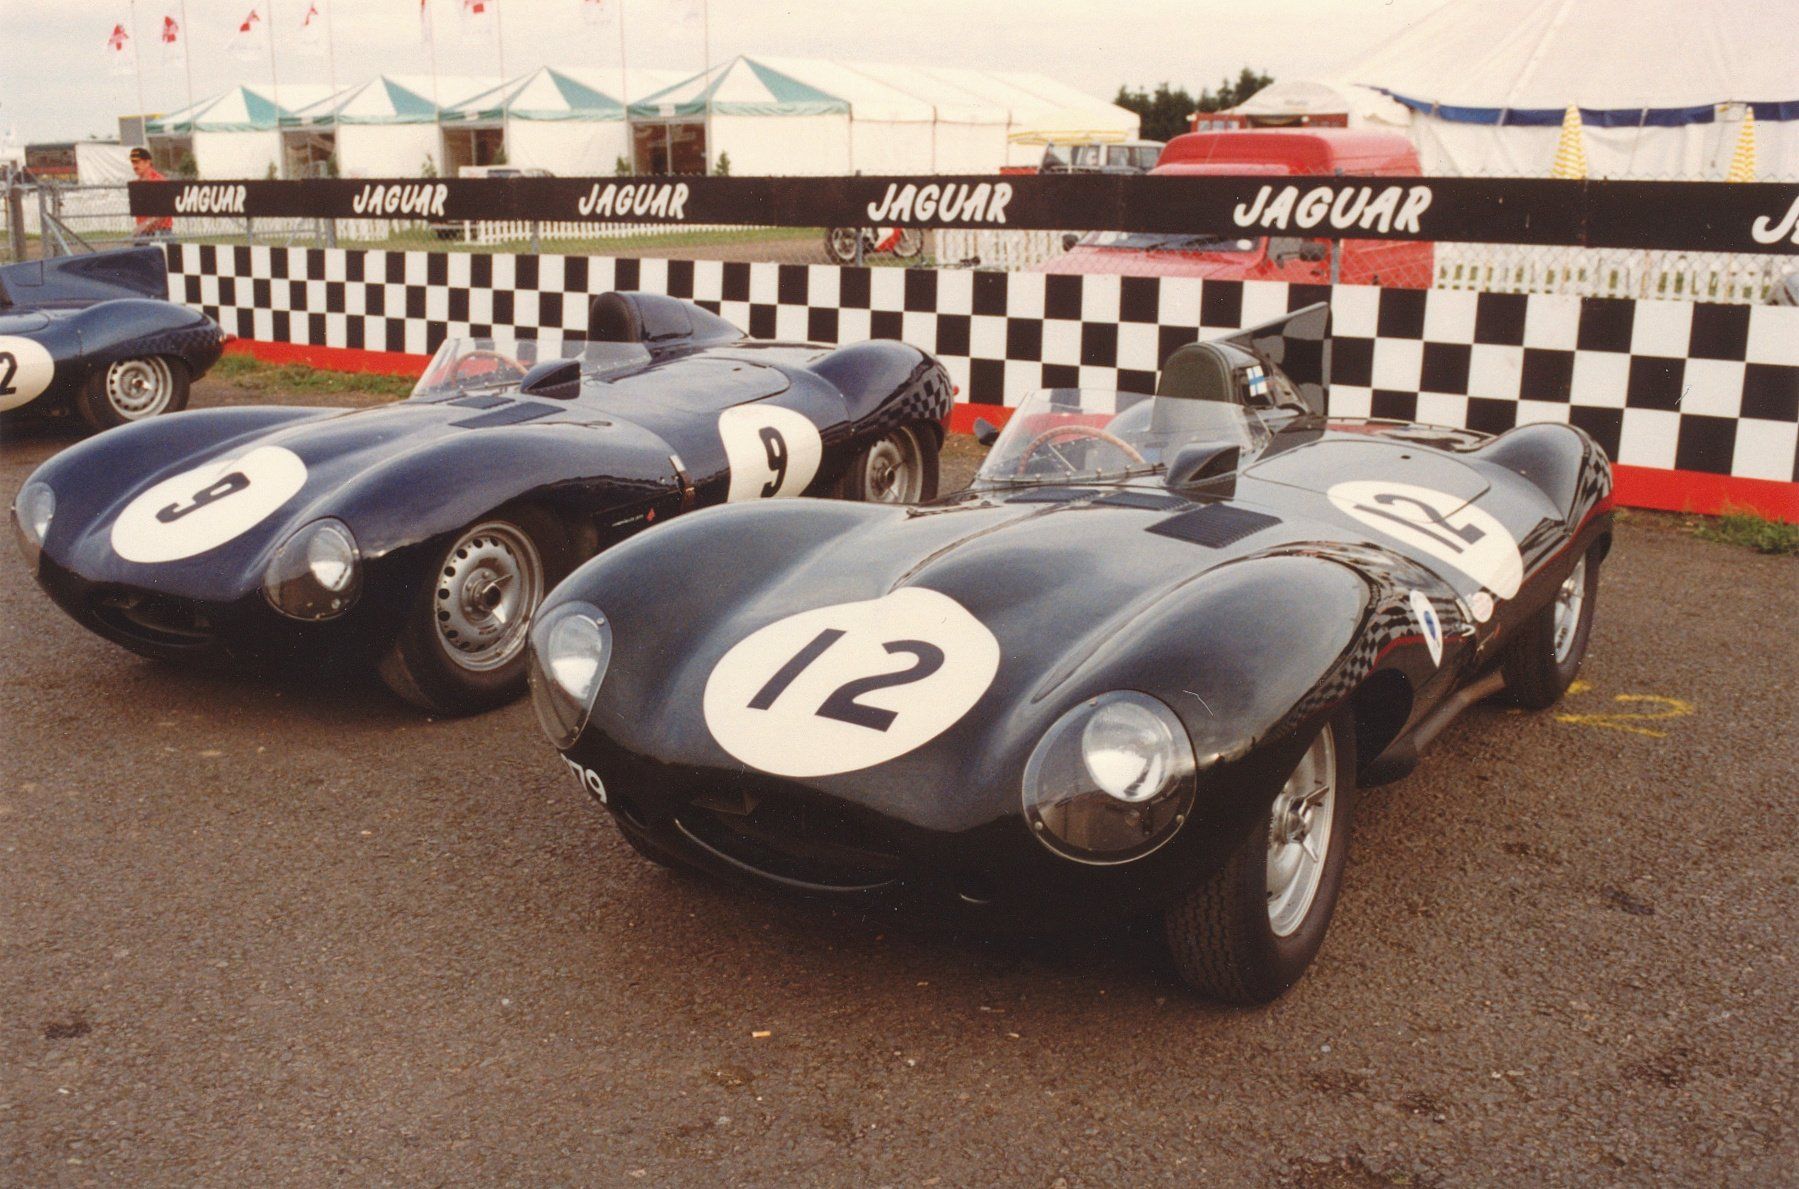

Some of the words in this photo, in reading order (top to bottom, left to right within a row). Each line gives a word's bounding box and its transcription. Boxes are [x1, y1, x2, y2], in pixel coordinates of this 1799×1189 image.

[174, 184, 247, 214] JAGUAR
[353, 184, 448, 217] JAGUAR
[578, 183, 689, 220] JAGUAR
[868, 182, 1013, 224] JAGUAR
[1233, 184, 1433, 234] JAGUAR
[760, 426, 788, 499] 9
[155, 471, 251, 524] 9
[1353, 493, 1487, 554] 12
[747, 628, 945, 733] 12
[560, 752, 608, 804] 79
